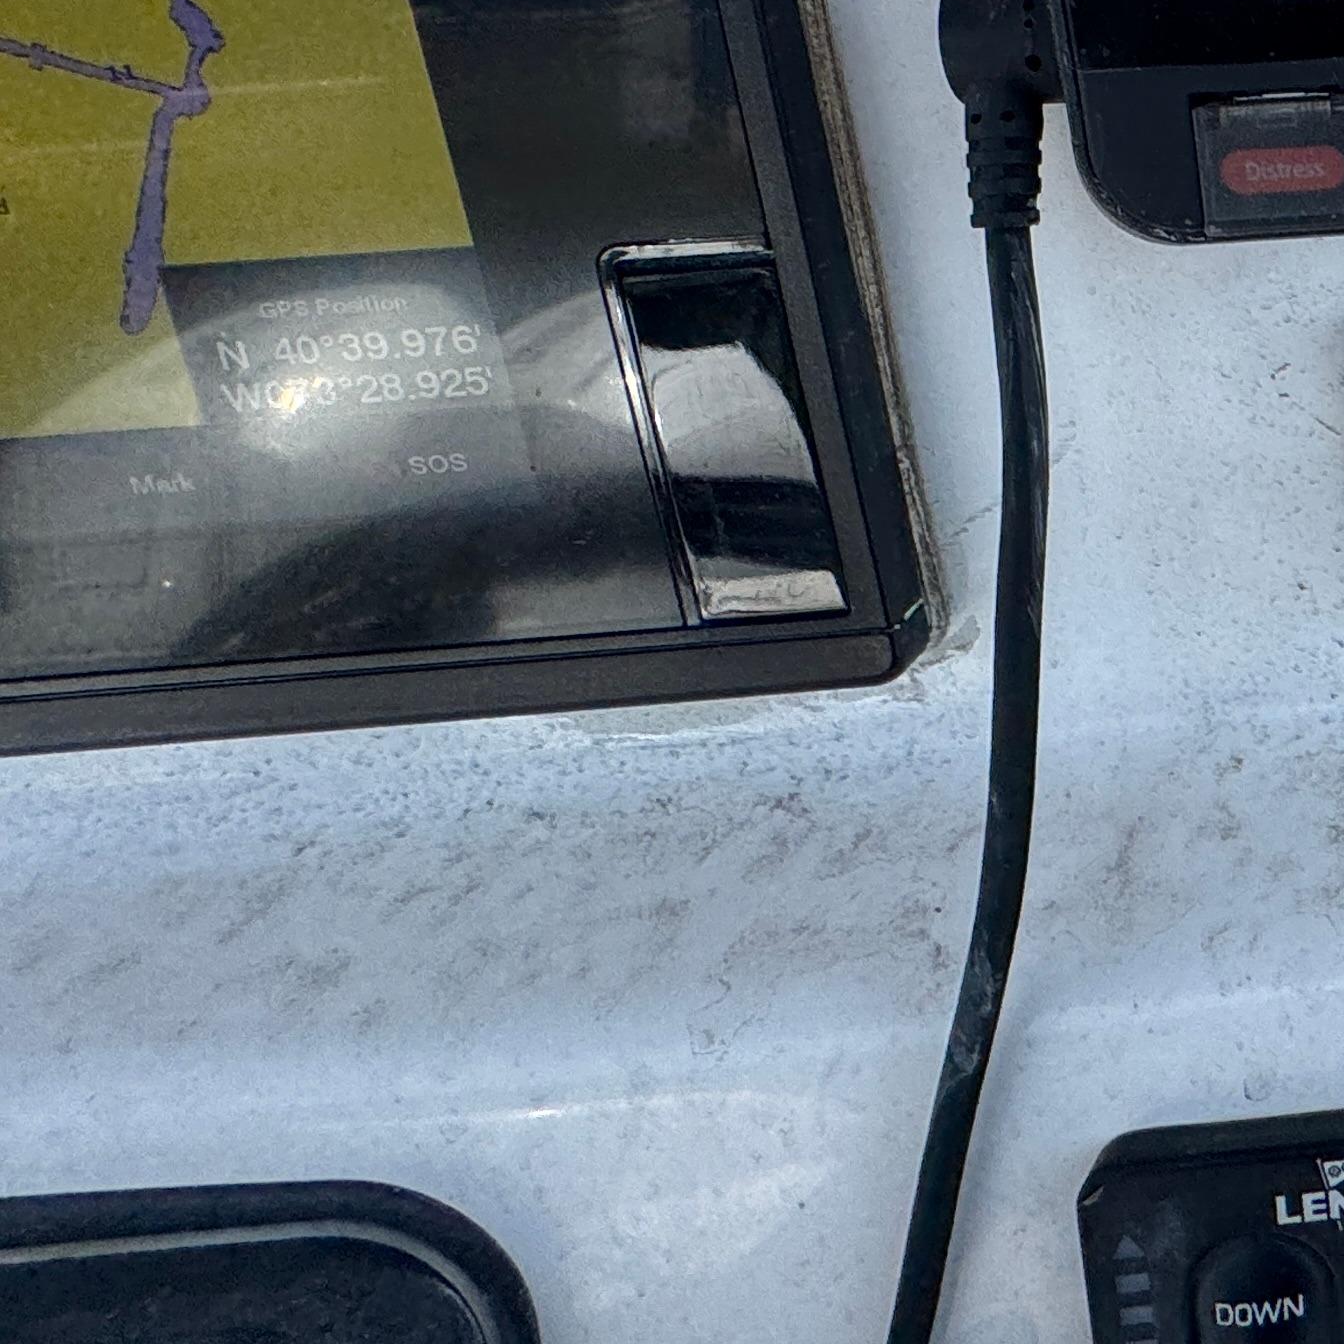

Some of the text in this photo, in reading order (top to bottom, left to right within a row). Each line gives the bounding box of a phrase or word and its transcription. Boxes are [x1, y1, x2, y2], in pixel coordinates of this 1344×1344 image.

[1245, 160, 1325, 181] Distress
[258, 295, 407, 318] GPS Position
[215, 340, 250, 370] N
[407, 453, 469, 475] SOS
[1214, 1293, 1305, 1327] DOWN
